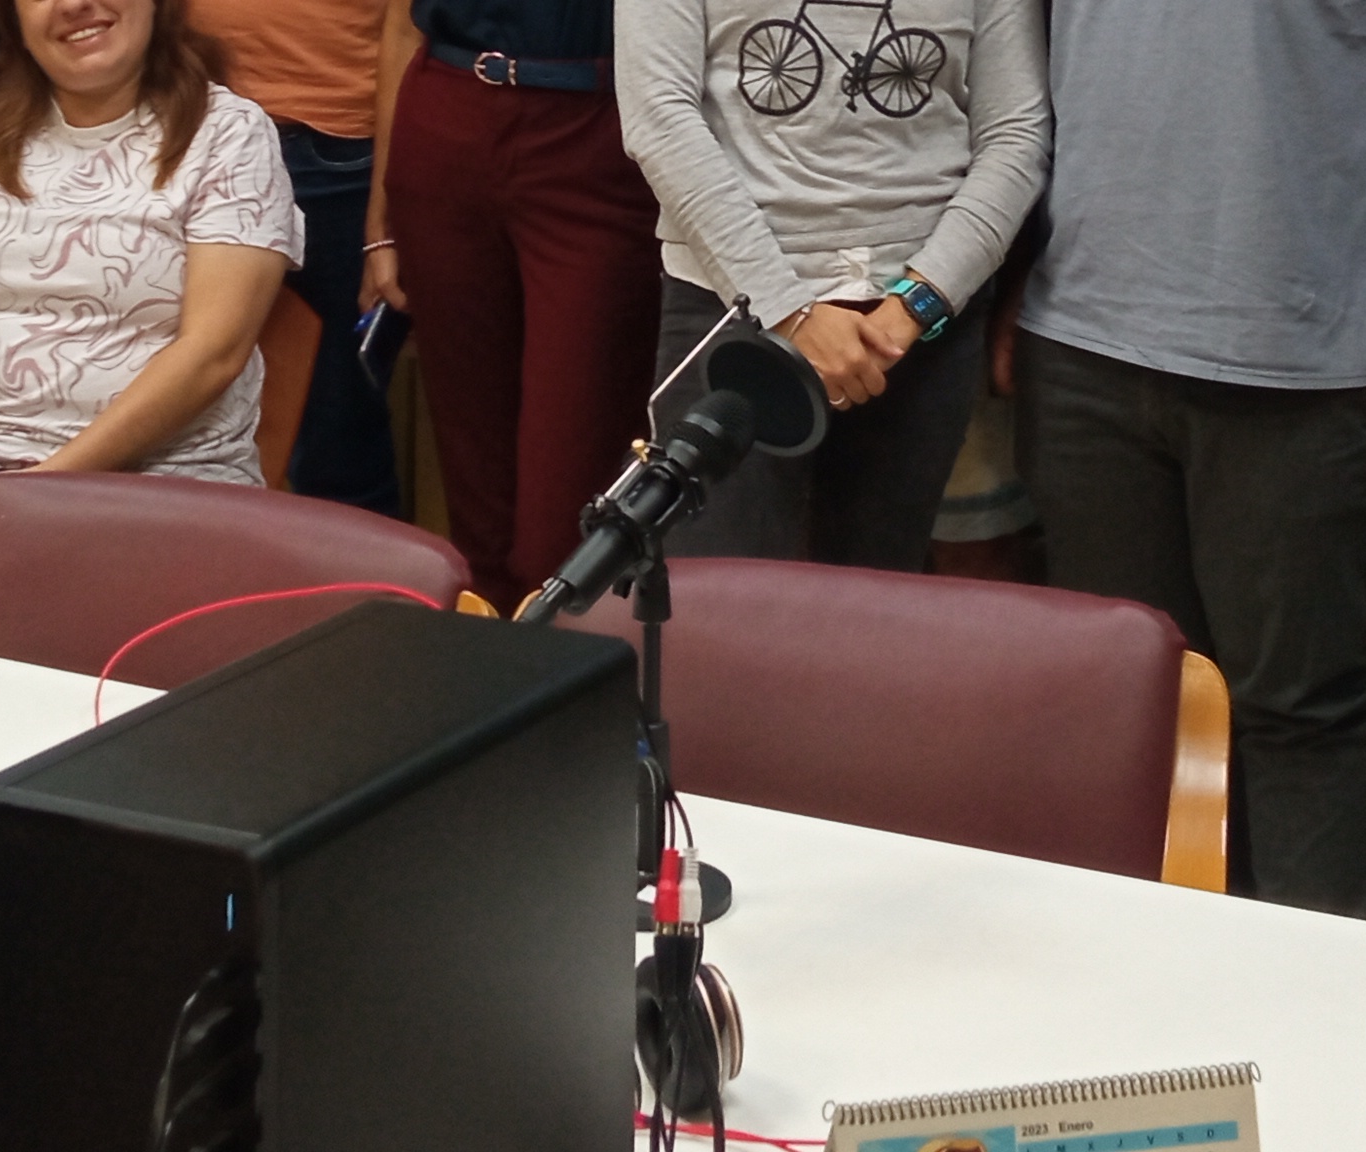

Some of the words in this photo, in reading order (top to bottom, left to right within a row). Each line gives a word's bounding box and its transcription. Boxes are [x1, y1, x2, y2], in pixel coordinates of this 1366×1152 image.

[1021, 1123, 1049, 1137] 2023
[1058, 1121, 1094, 1133] Enero
[1146, 1135, 1154, 1145] V
